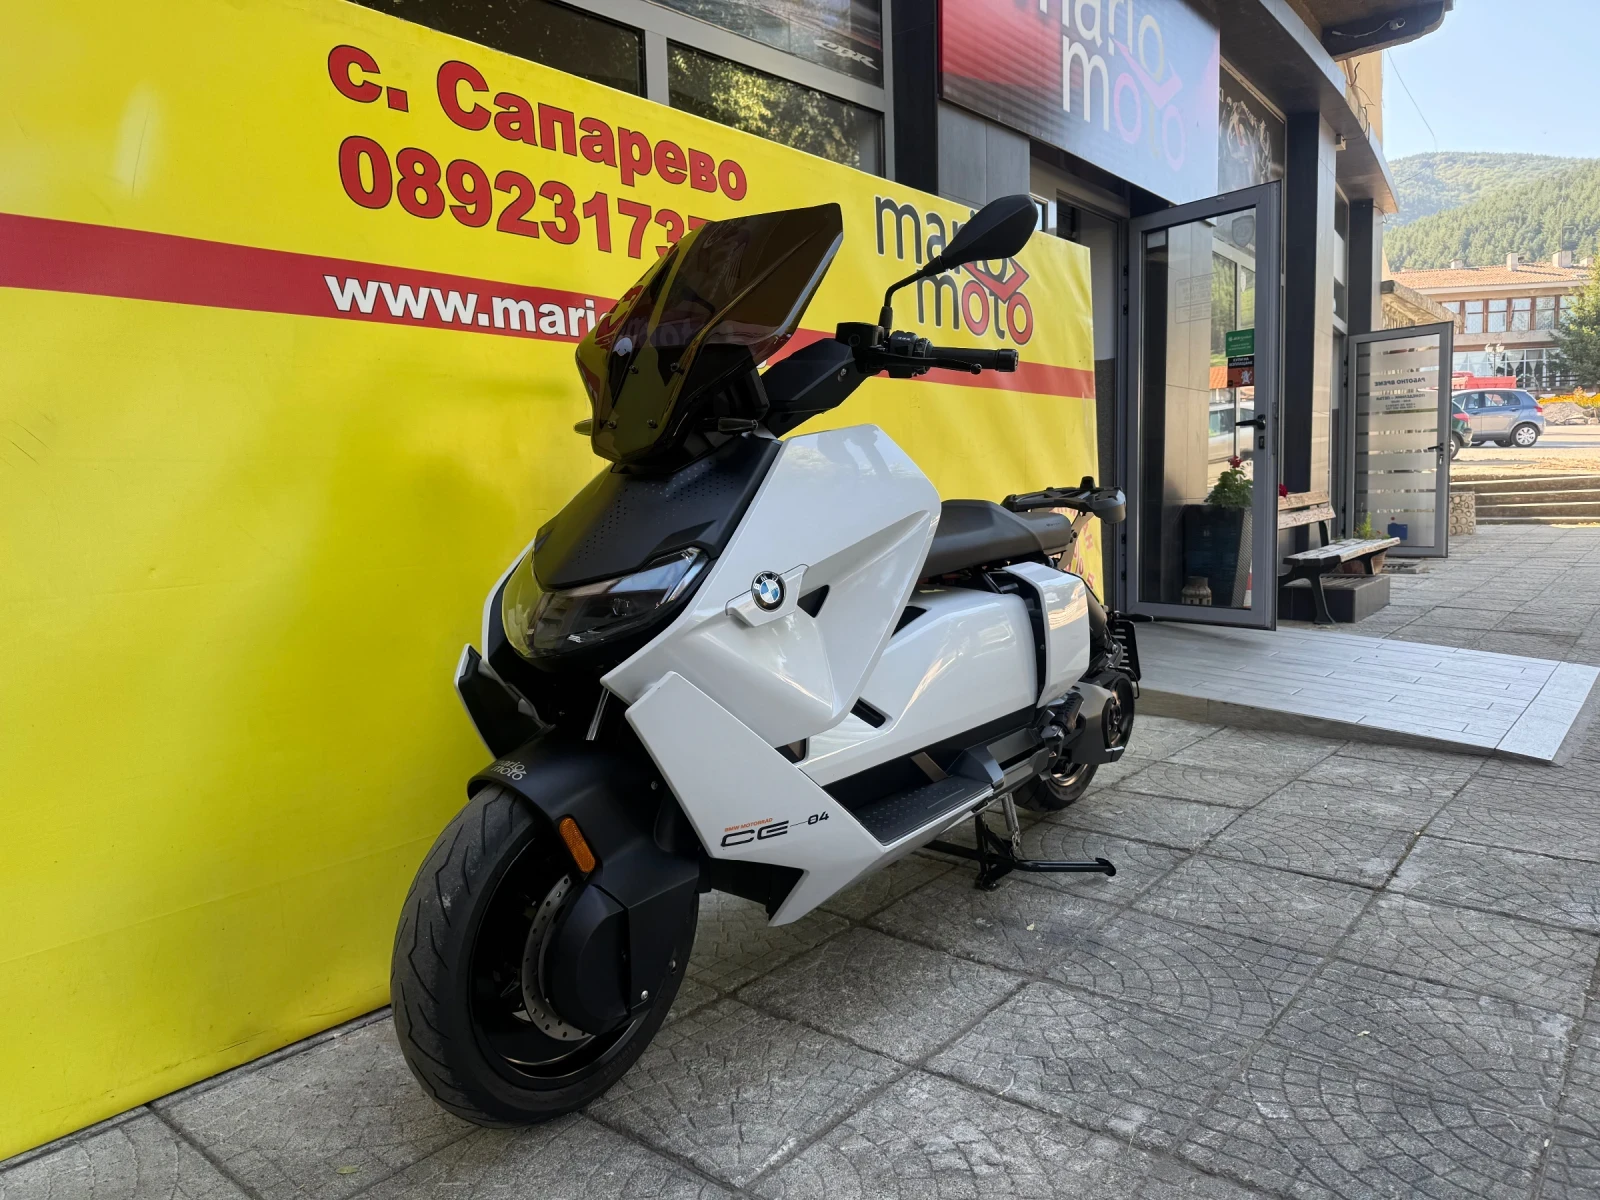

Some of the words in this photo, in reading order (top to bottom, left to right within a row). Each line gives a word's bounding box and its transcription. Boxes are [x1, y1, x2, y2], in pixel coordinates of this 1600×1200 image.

[328, 44, 408, 112] с.
[436, 60, 748, 201] Сапарево
[1062, 35, 1186, 173] moto
[916, 269, 1033, 346] moto
[753, 573, 779, 590] BMW
[741, 817, 773, 829] MOTORRAD
